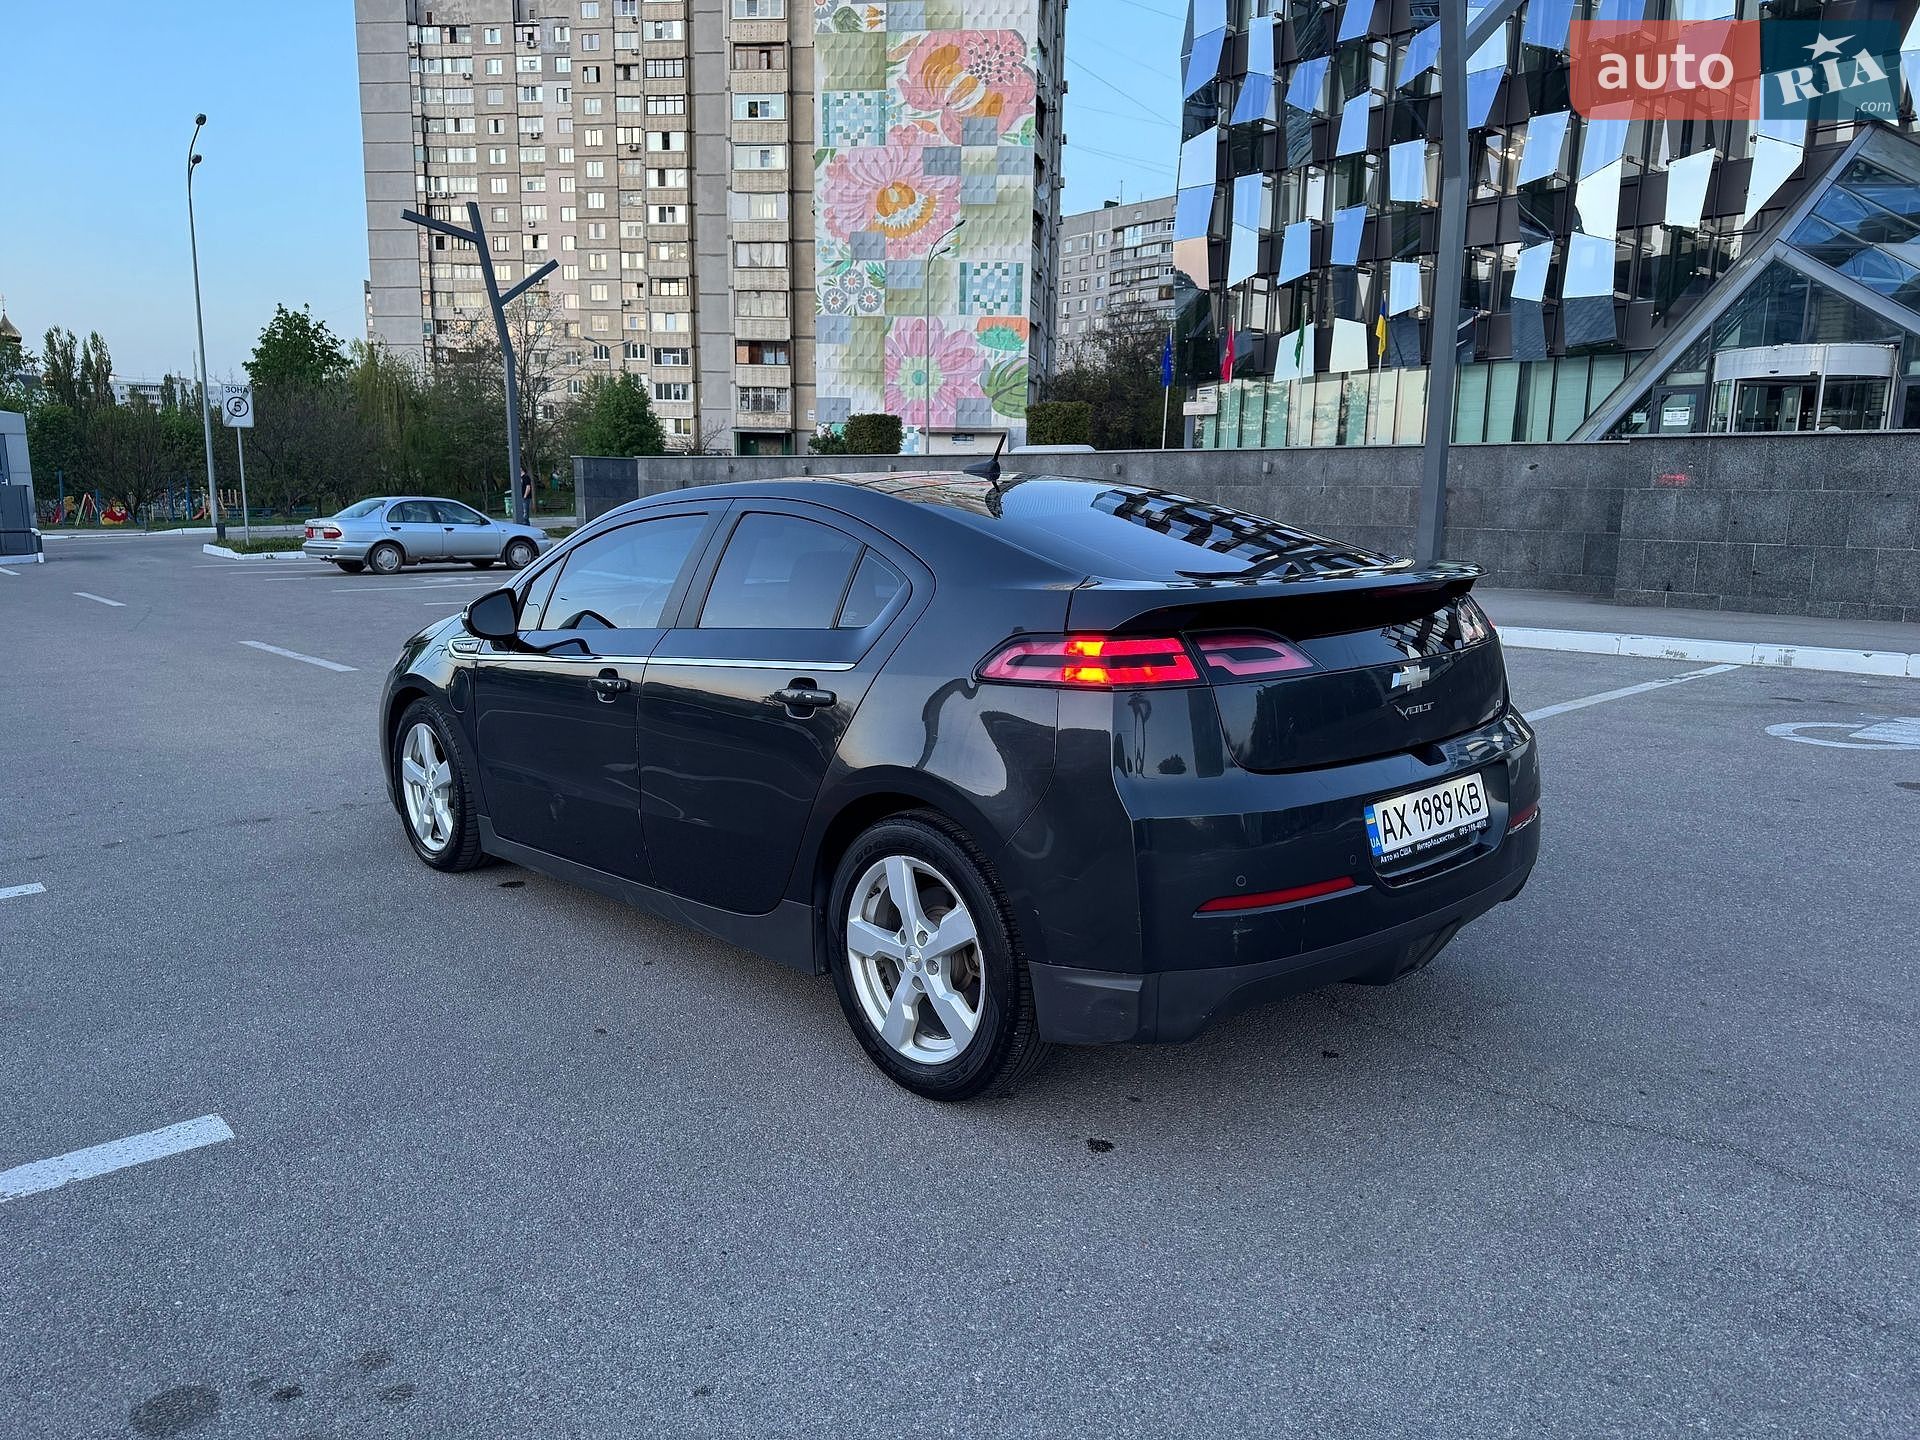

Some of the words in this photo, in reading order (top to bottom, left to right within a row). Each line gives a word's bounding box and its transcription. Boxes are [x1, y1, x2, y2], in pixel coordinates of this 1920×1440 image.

[225, 386, 249, 394] ЗОНА
[234, 401, 242, 412] 5
[1394, 702, 1434, 720] VOLT
[1382, 803, 1413, 845] AX
[1412, 790, 1453, 832] 1989
[1454, 782, 1481, 819] KB
[1370, 836, 1381, 848] UA
